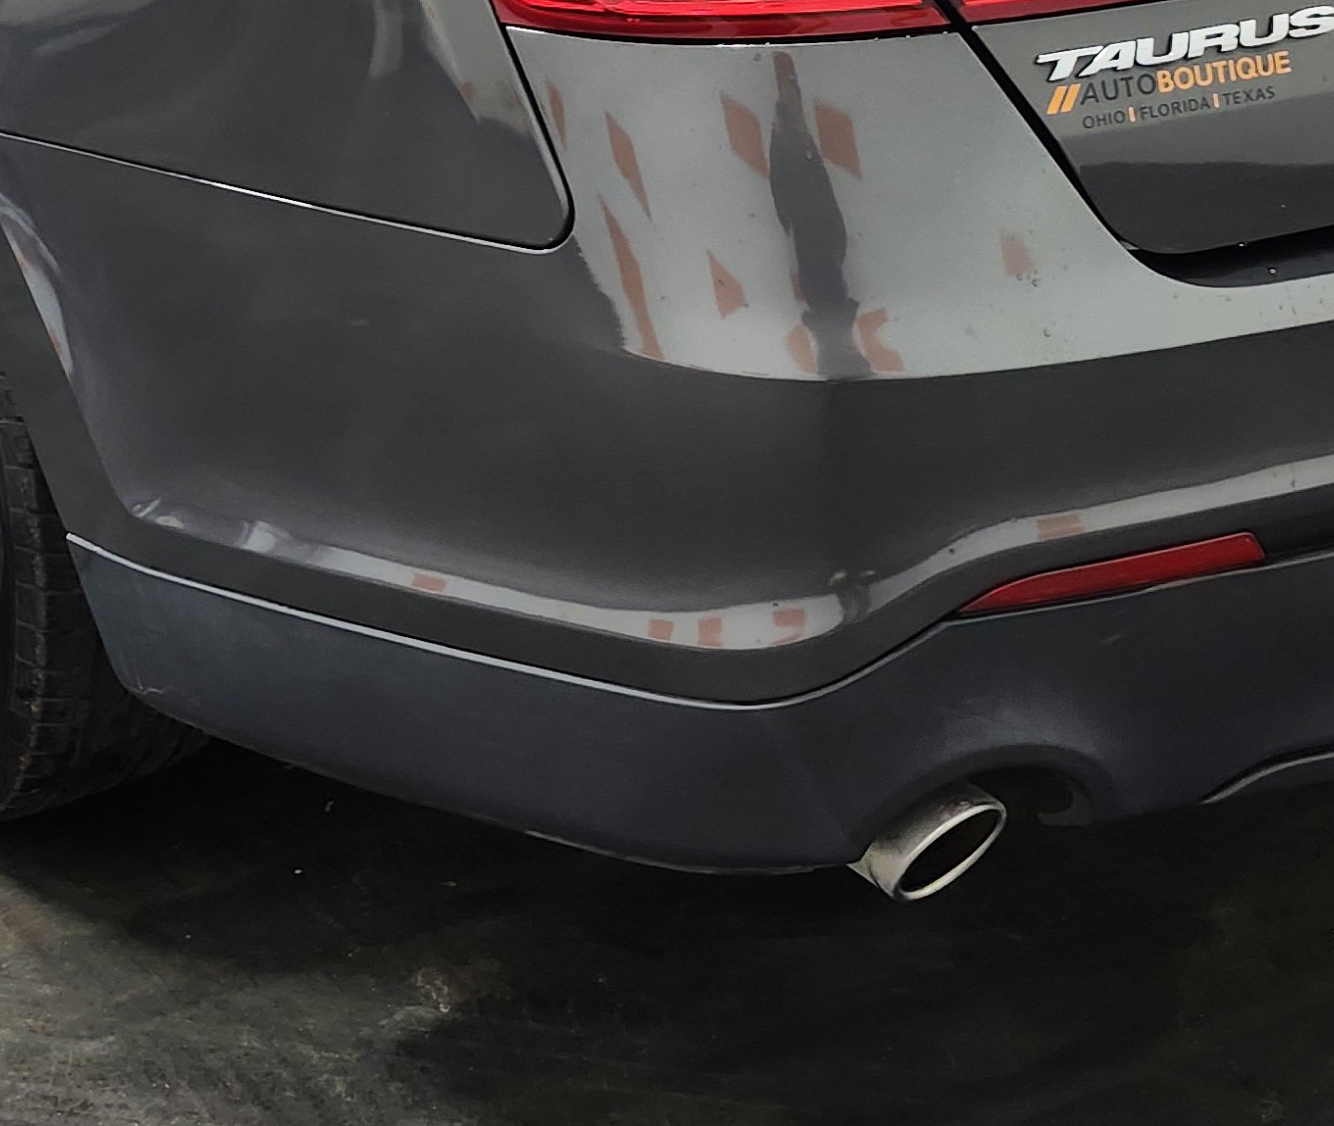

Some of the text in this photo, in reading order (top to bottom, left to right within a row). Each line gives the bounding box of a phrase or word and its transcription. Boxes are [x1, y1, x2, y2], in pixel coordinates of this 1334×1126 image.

[1080, 51, 1292, 106] AUTOBOUTIQUE
[1082, 86, 1275, 129] OHIO FLORIDA TEXAS
